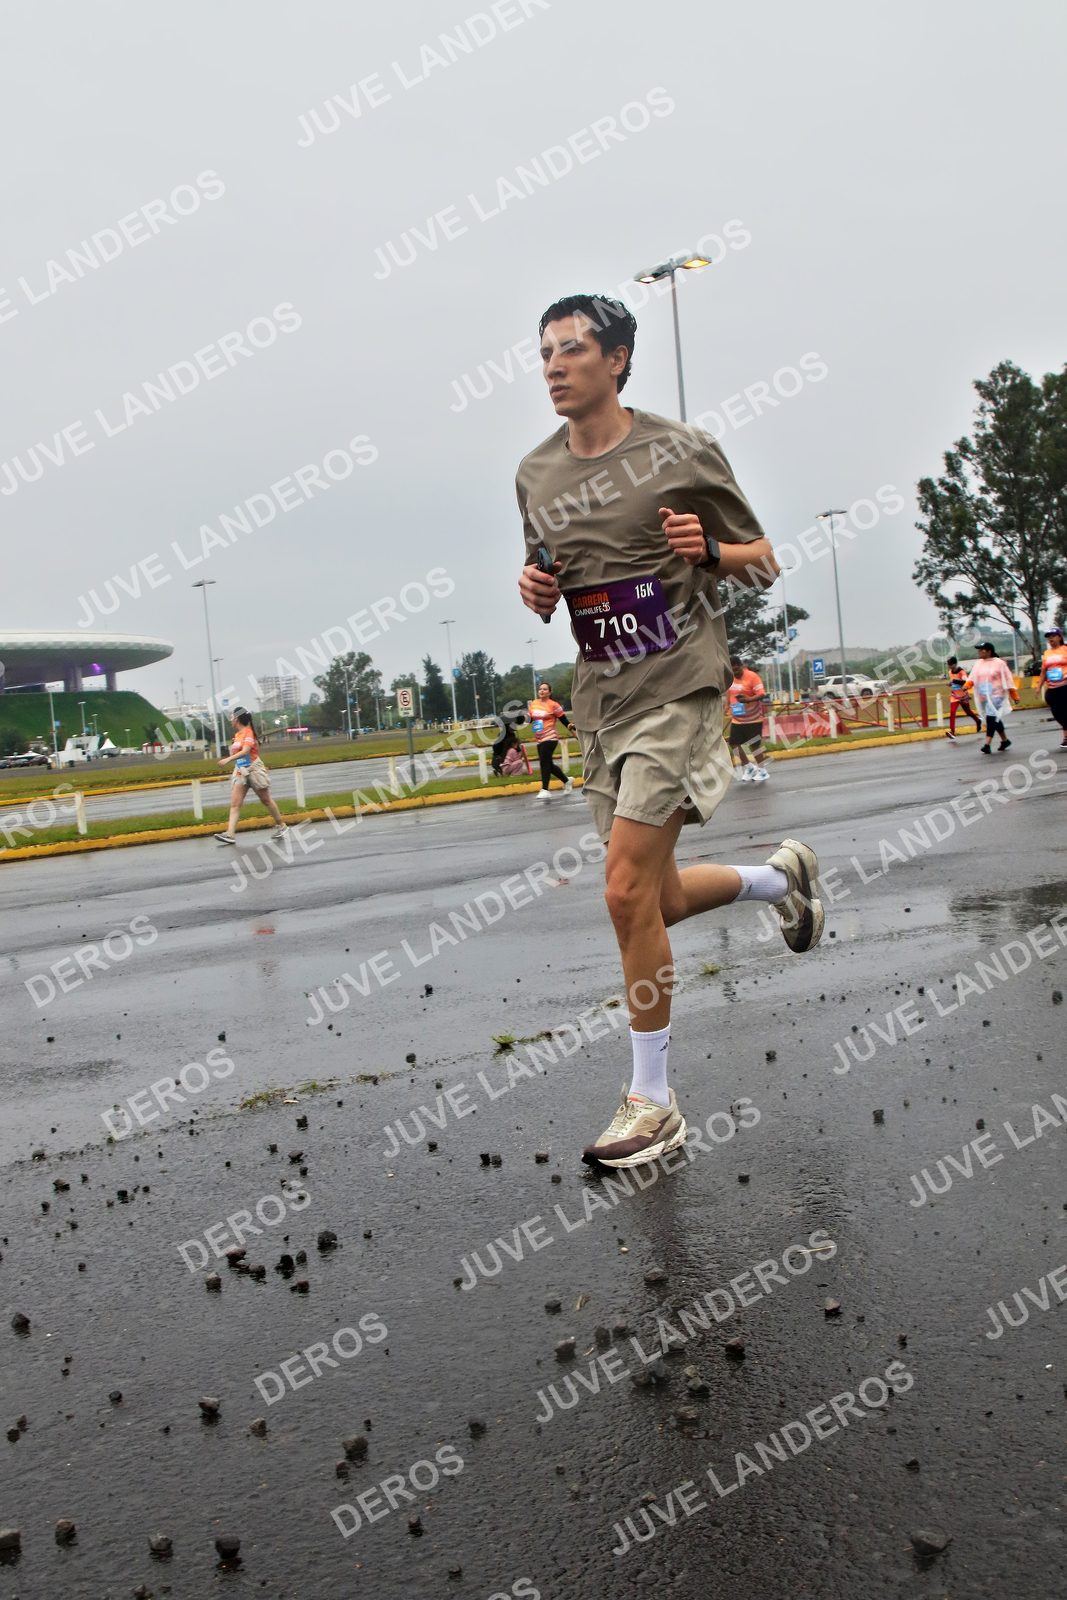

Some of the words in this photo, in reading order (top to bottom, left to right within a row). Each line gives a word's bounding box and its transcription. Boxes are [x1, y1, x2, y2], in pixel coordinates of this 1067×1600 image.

[635, 582, 655, 599] 15K
[572, 592, 609, 608] CARRERA
[594, 613, 638, 639] 710
